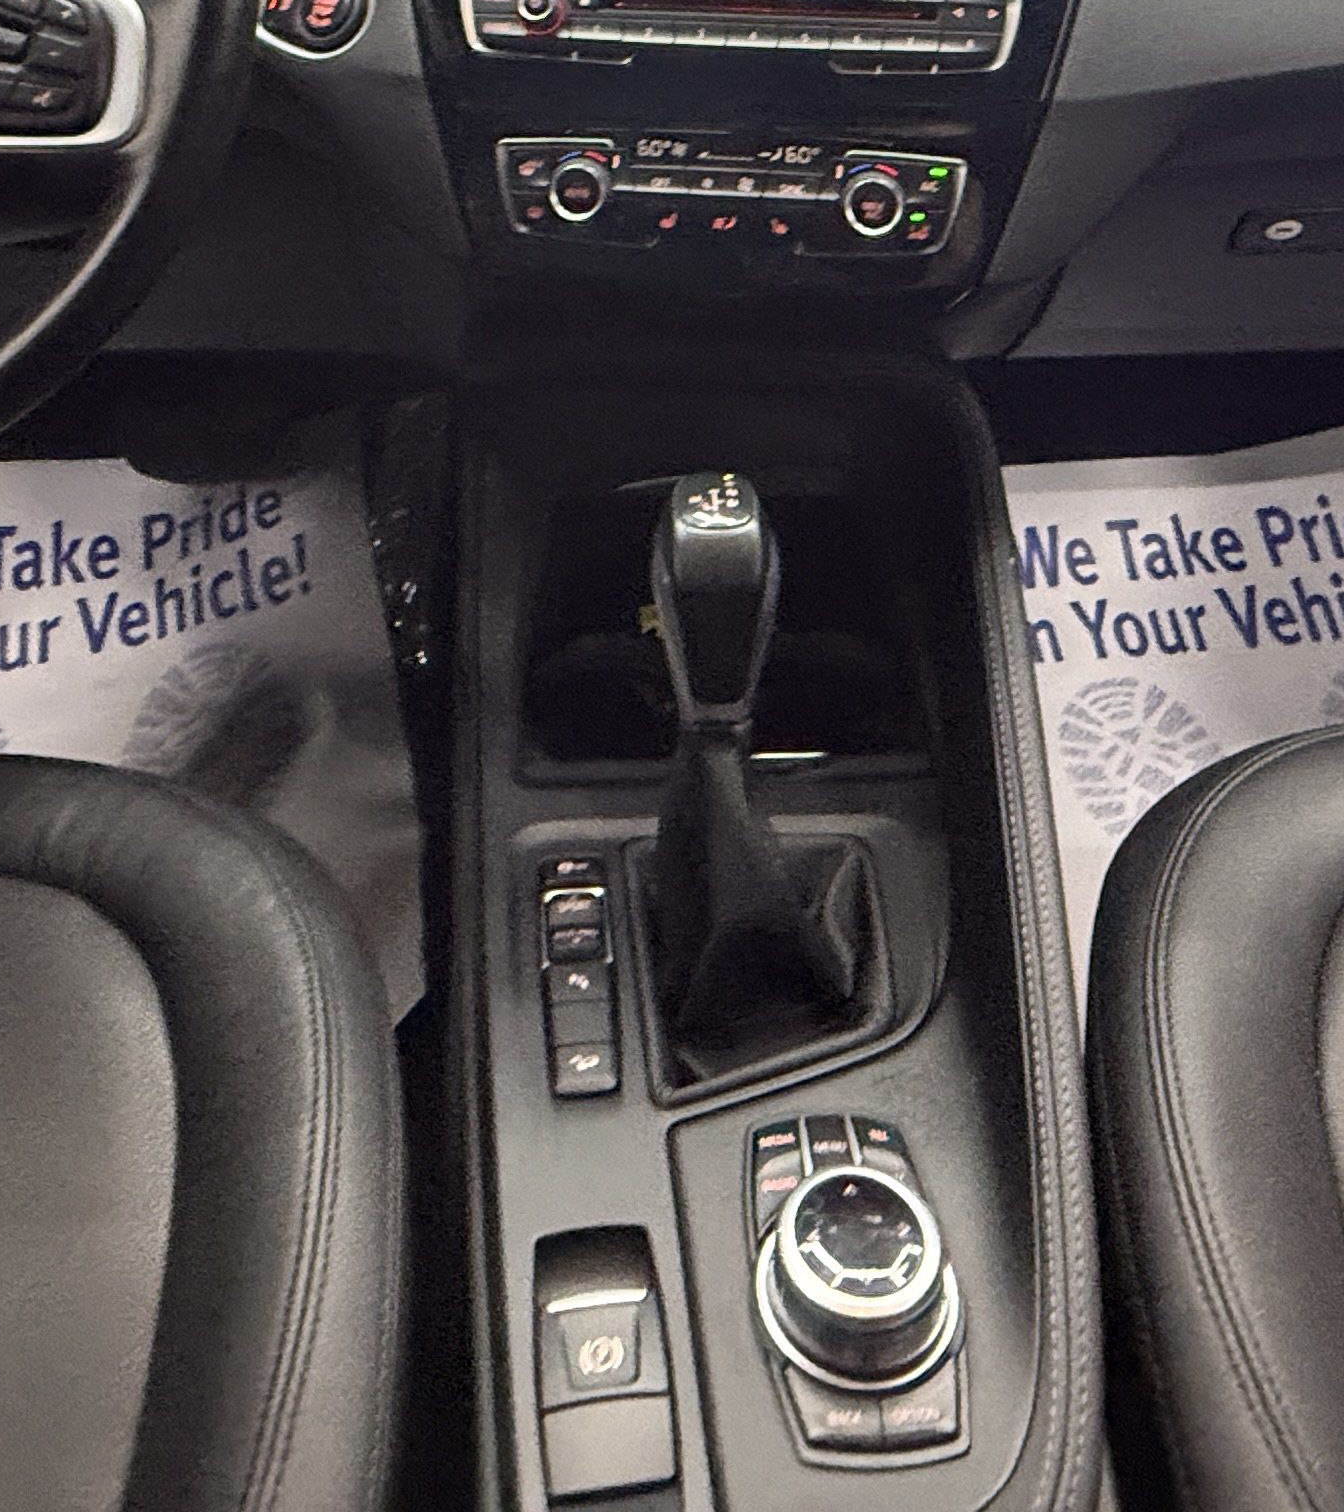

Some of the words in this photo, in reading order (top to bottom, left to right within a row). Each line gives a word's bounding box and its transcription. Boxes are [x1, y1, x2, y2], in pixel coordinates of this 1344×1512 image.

[142, 485, 283, 571] Pride
[1018, 524, 1099, 589] We
[1104, 513, 1248, 581] Take
[76, 534, 313, 654] Vehicle!
[1069, 598, 1208, 659] Your
